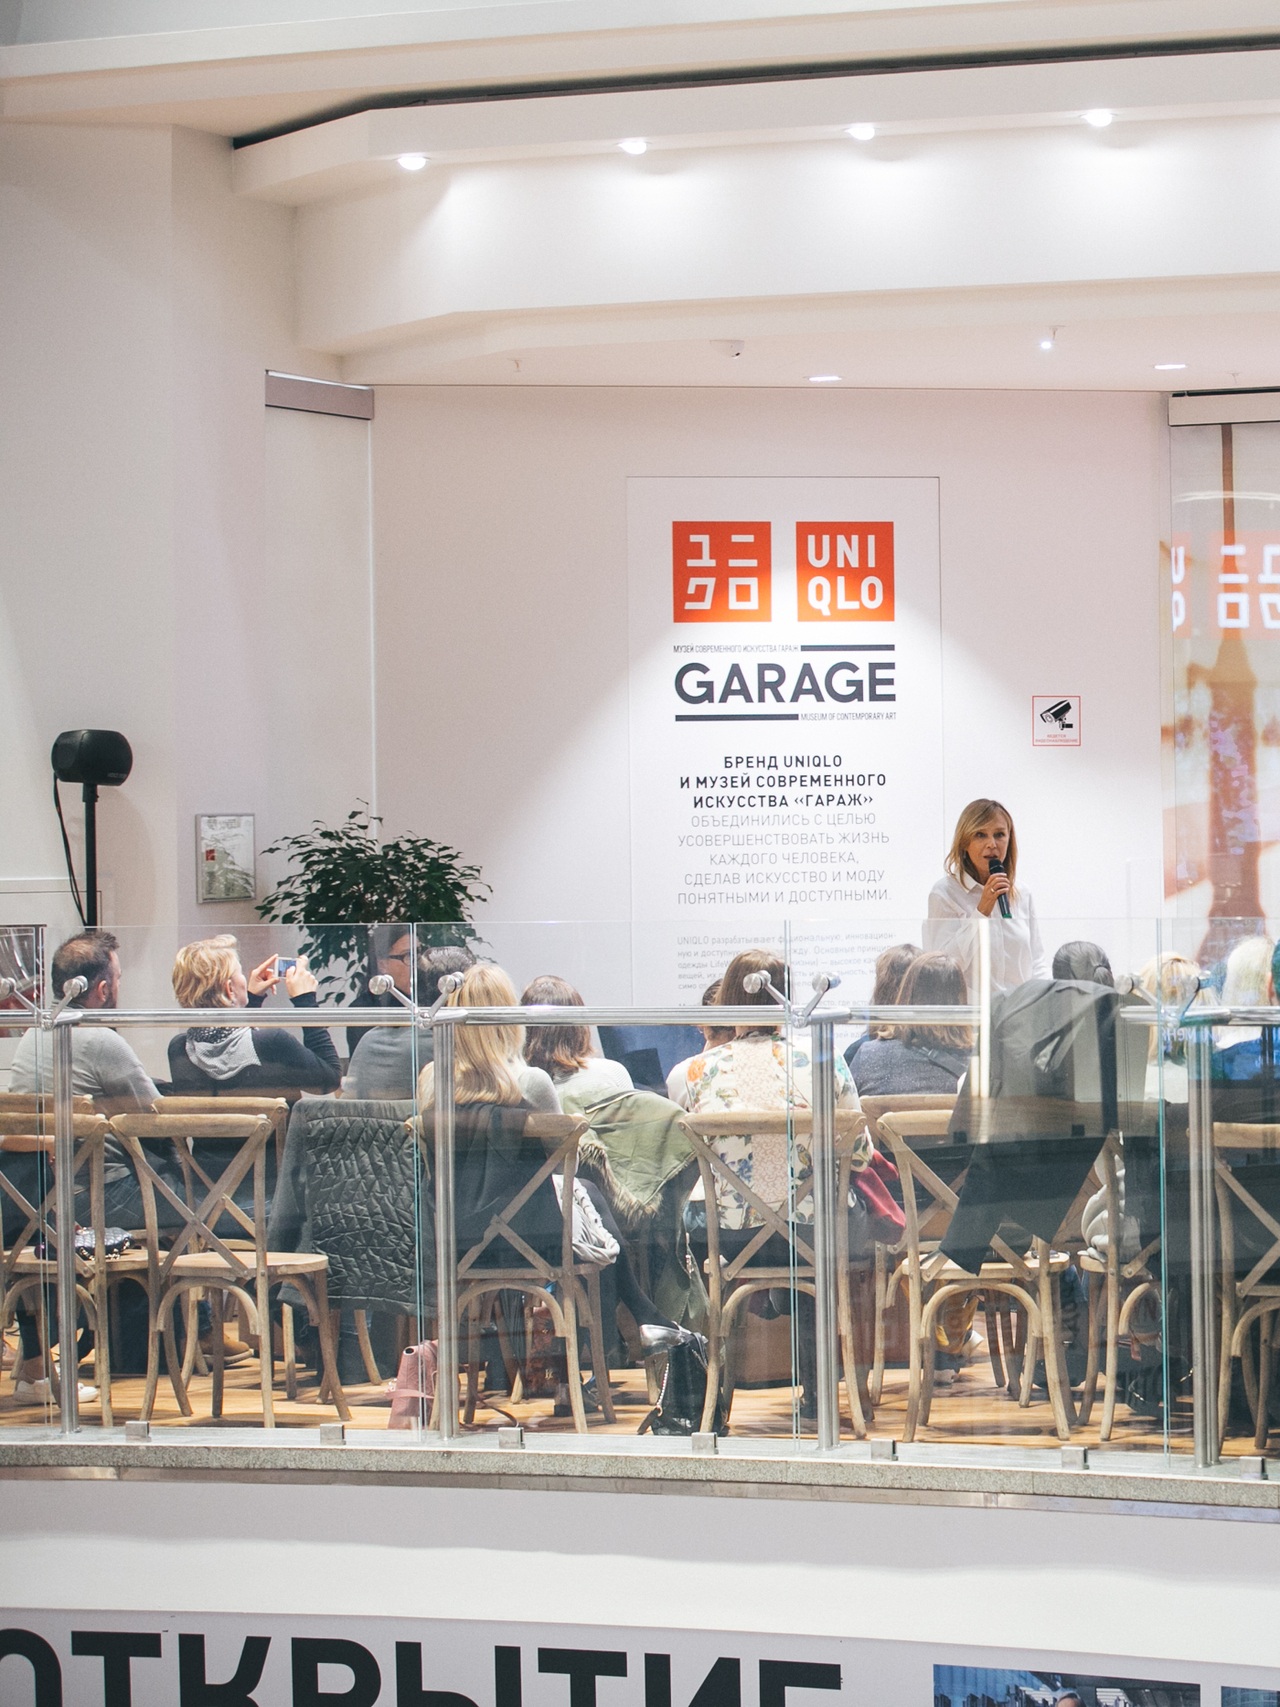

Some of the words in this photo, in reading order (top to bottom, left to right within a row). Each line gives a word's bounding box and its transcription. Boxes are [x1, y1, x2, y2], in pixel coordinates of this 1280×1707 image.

[807, 534, 876, 568] UNI
[807, 576, 884, 616] QLO
[673, 643, 694, 653] МУЗЕЙ
[695, 644, 741, 653] СОВРЕМЕННОГО
[743, 644, 777, 652] ИСКУССТВА
[675, 662, 896, 704] GARAGE
[801, 713, 827, 721] MUSEUM
[836, 712, 884, 720] CONTEMPORARY
[885, 712, 897, 720] ART
[723, 756, 778, 770] БРЕНД
[784, 755, 842, 768] UNIQLO
[680, 776, 690, 788] И
[696, 773, 751, 788] МУЗЕЙ
[756, 774, 886, 788] СОВРЕМЕННОГО
[693, 795, 789, 808] ИСКУССТВА
[691, 814, 809, 828] ОБЪЕДИНИЛИСЬ
[814, 813, 822, 825] С
[826, 812, 876, 826] ЦЕЛЬЮ
[678, 832, 834, 847] УСОВЕРШЕНСТВОВАТЬ
[838, 832, 890, 844] ЖИЗНЬ
[709, 853, 778, 867] КАЖДОГО
[782, 851, 859, 865] ЧЕЛОВЕКА,
[684, 872, 741, 887] СДЕЛАВ
[745, 871, 827, 884] ИСКУССТВО
[832, 871, 841, 882] И
[846, 870, 885, 883] МОДУ
[678, 891, 770, 905] ПОНЯТНЫМИ
[775, 891, 784, 903] И
[788, 889, 892, 904] ДОСТУПНЫМИ.
[677, 936, 709, 945] UNIQLO
